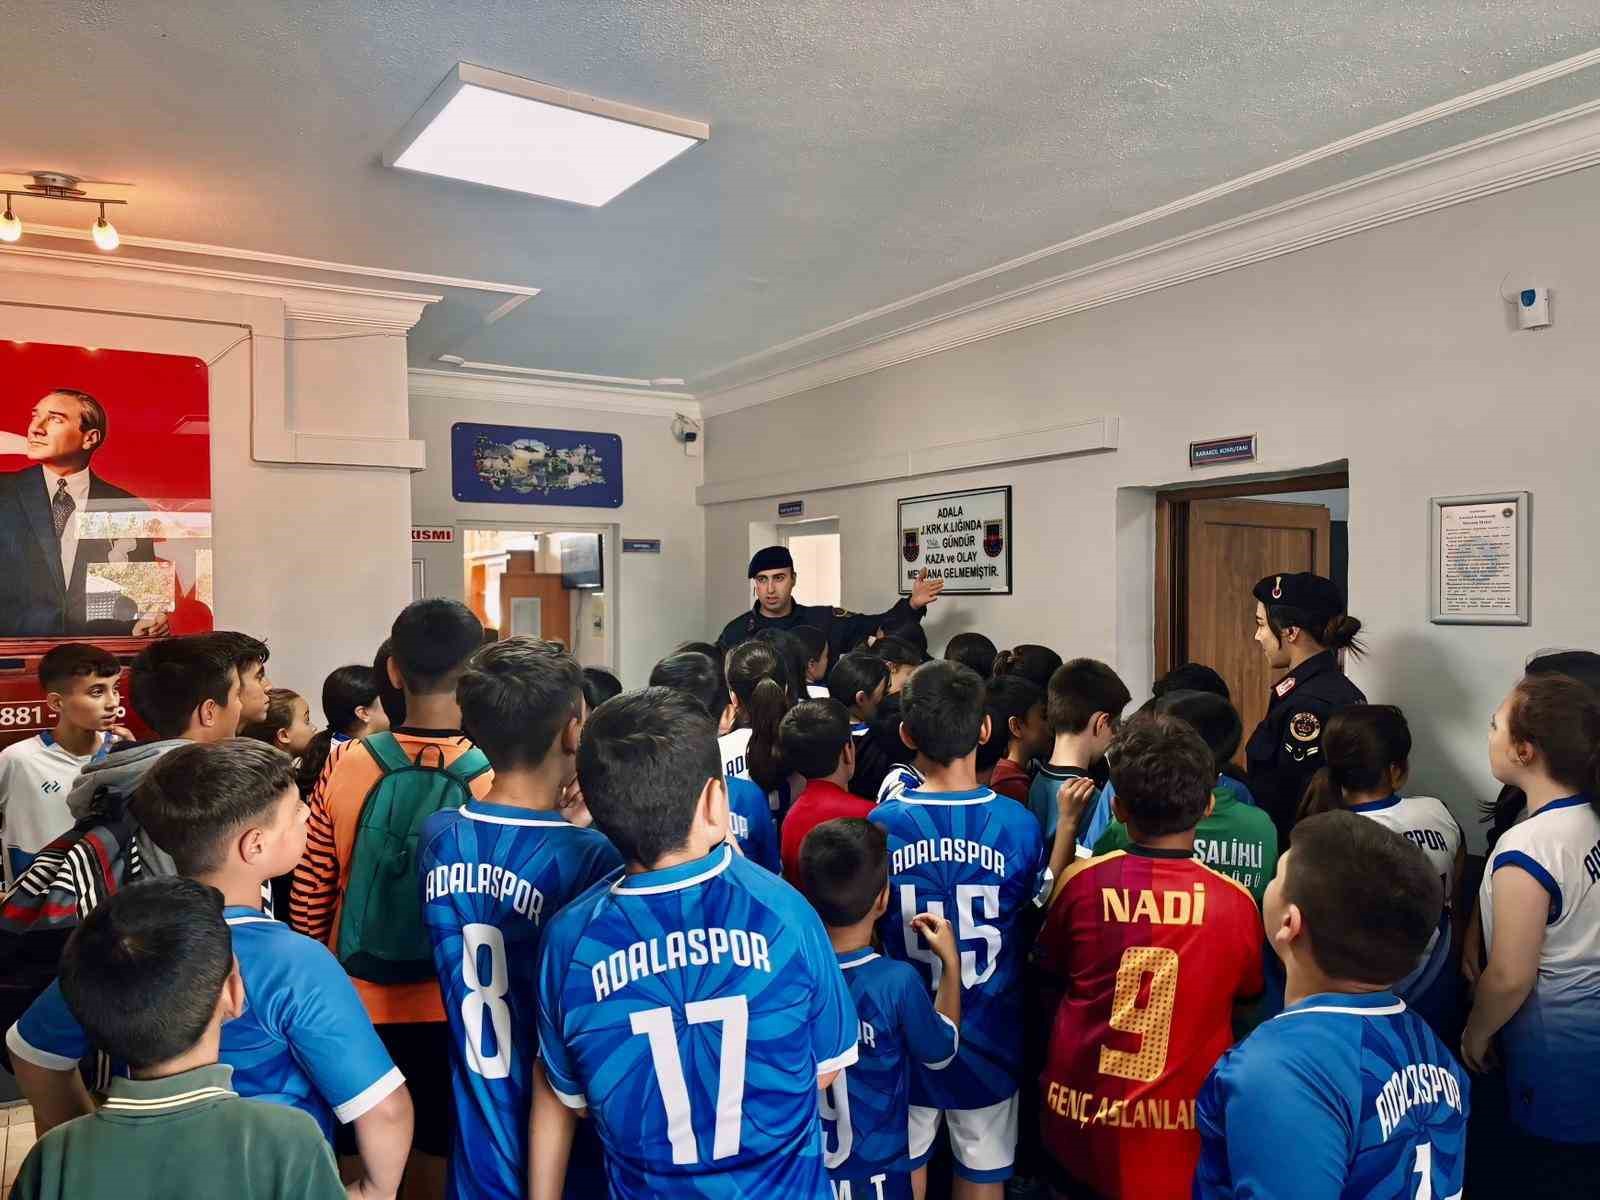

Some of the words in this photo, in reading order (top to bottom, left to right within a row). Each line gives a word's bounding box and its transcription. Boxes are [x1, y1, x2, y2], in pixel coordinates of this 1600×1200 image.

[937, 505, 963, 519] ADALA
[925, 553, 945, 565] KAZA
[946, 554, 956, 564] ve
[956, 551, 977, 563] OLAY
[942, 533, 976, 548] GÜNDÜR
[943, 563, 999, 580] GELMEMİŞTİR.
[888, 837, 1005, 878] ADALASPOR
[1192, 838, 1263, 869] SALİHLİ
[425, 862, 545, 928] ADALASPOR
[1101, 882, 1206, 926] NADİ
[591, 927, 771, 1002] ADALASPOR
[461, 922, 511, 1079] 8
[1098, 946, 1179, 1082] 9
[629, 995, 748, 1165] 17
[1047, 1081, 1094, 1129] GENÇ
